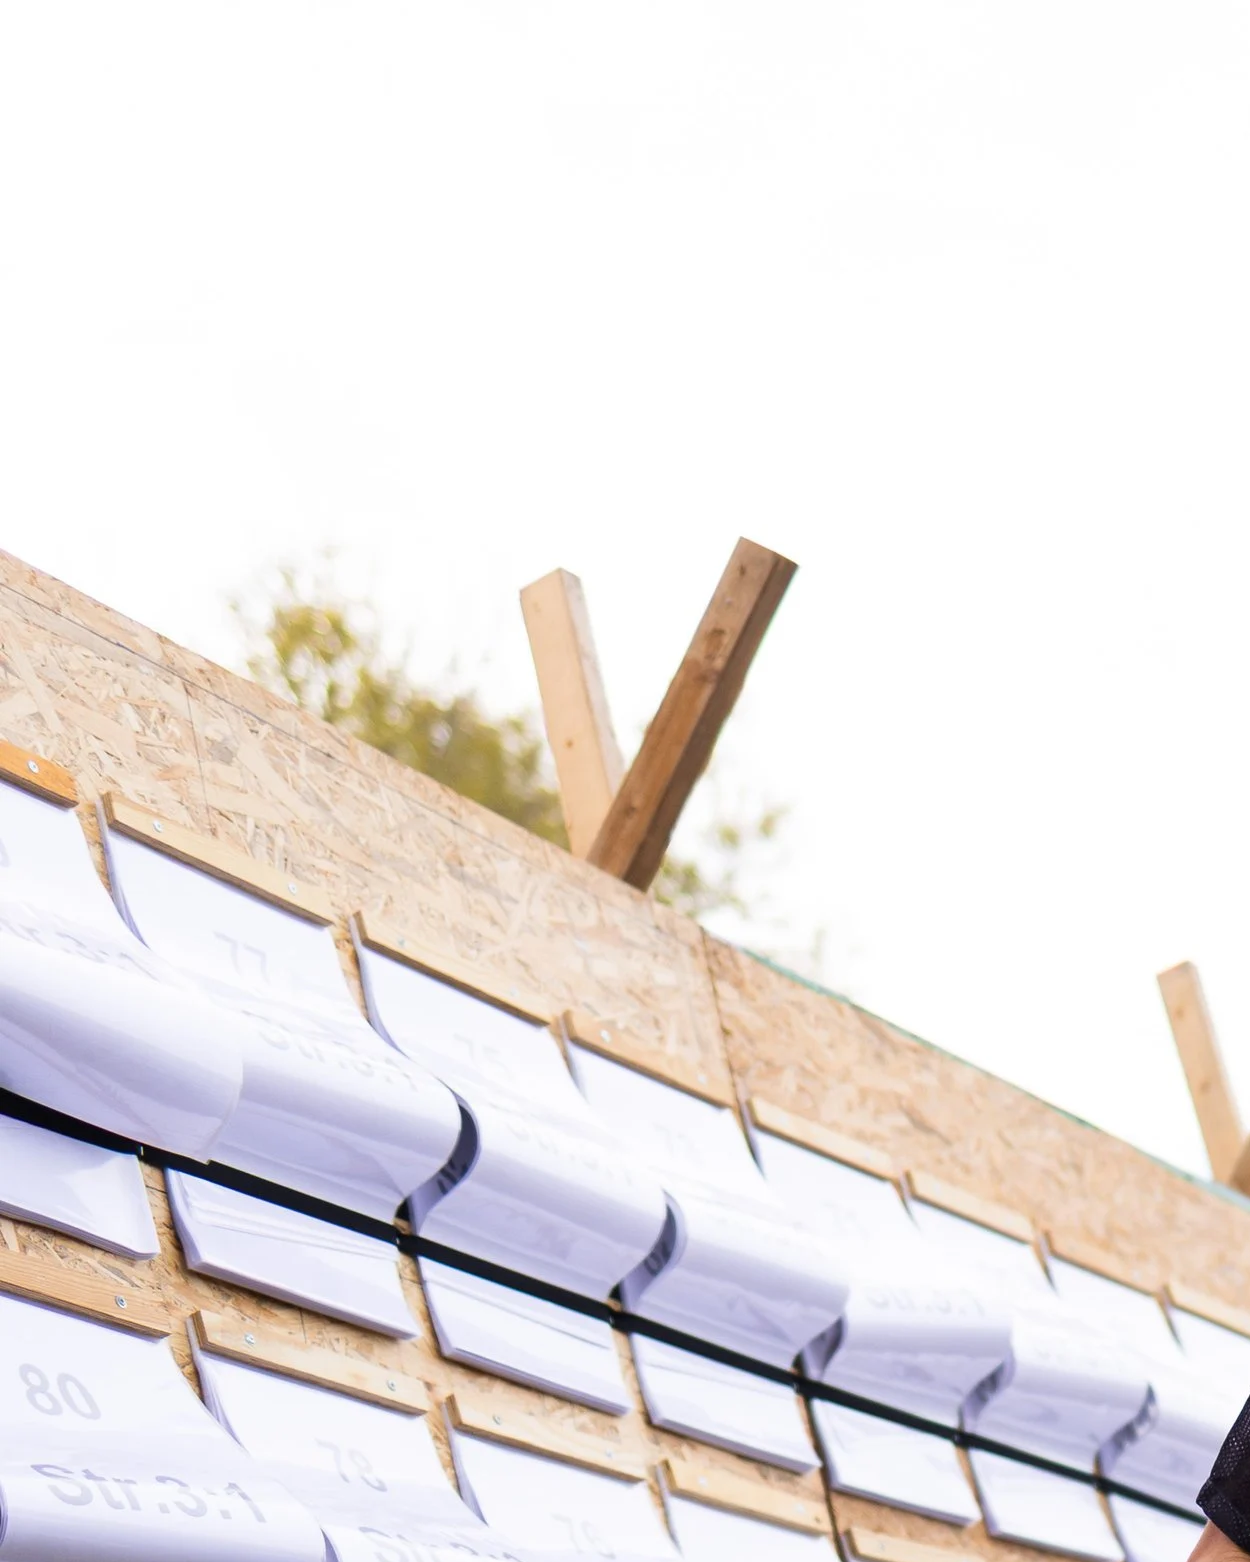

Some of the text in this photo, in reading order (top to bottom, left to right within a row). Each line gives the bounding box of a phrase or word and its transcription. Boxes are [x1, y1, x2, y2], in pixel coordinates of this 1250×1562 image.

[212, 930, 270, 984] 77
[18, 1362, 102, 1420] 80
[30, 1463, 267, 1524] Str.3:1
[314, 1437, 388, 1493] 78
